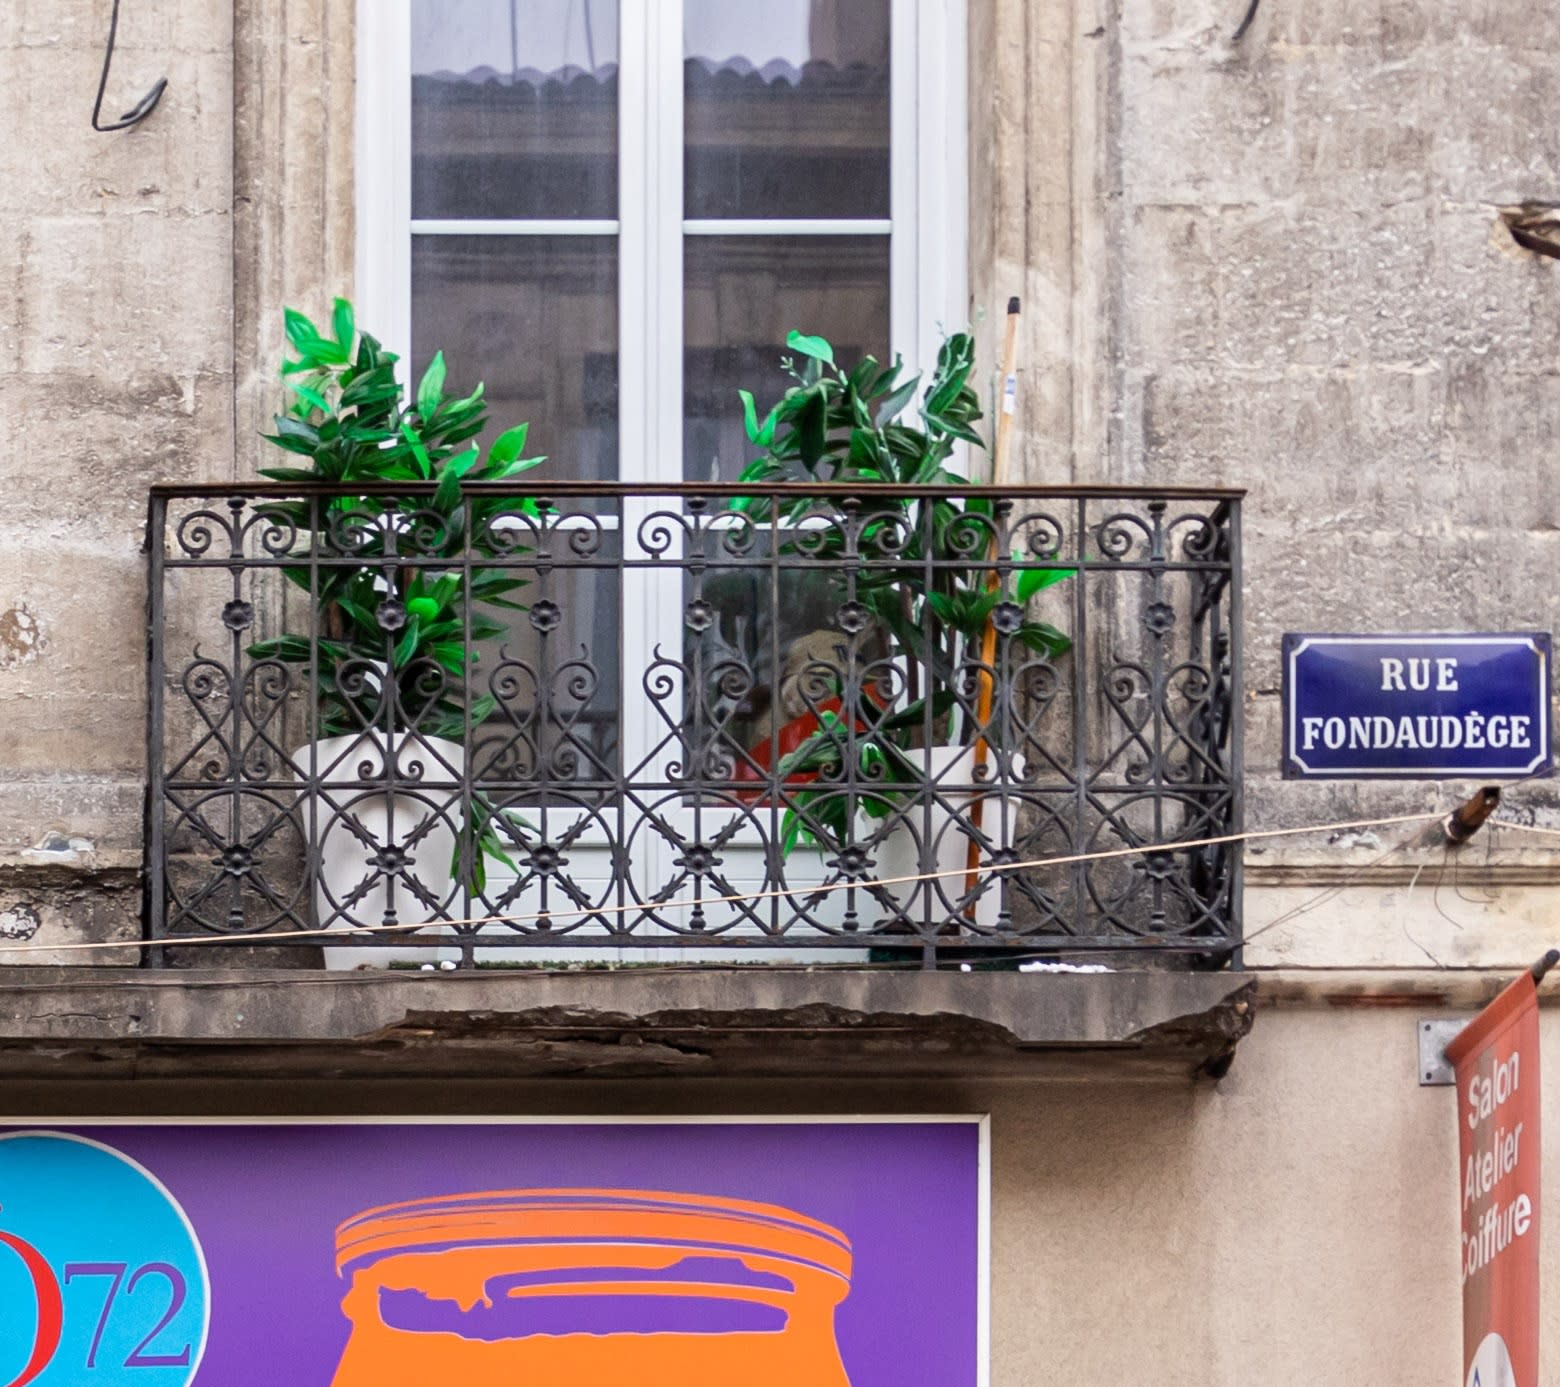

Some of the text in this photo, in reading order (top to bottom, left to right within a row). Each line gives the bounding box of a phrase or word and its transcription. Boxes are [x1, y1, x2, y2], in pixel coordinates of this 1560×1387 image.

[1380, 657, 1459, 692] RUE
[1302, 710, 1531, 750] FONDAUDÈGE
[1468, 1050, 1520, 1129] Salon
[1464, 1122, 1523, 1212] Atelier
